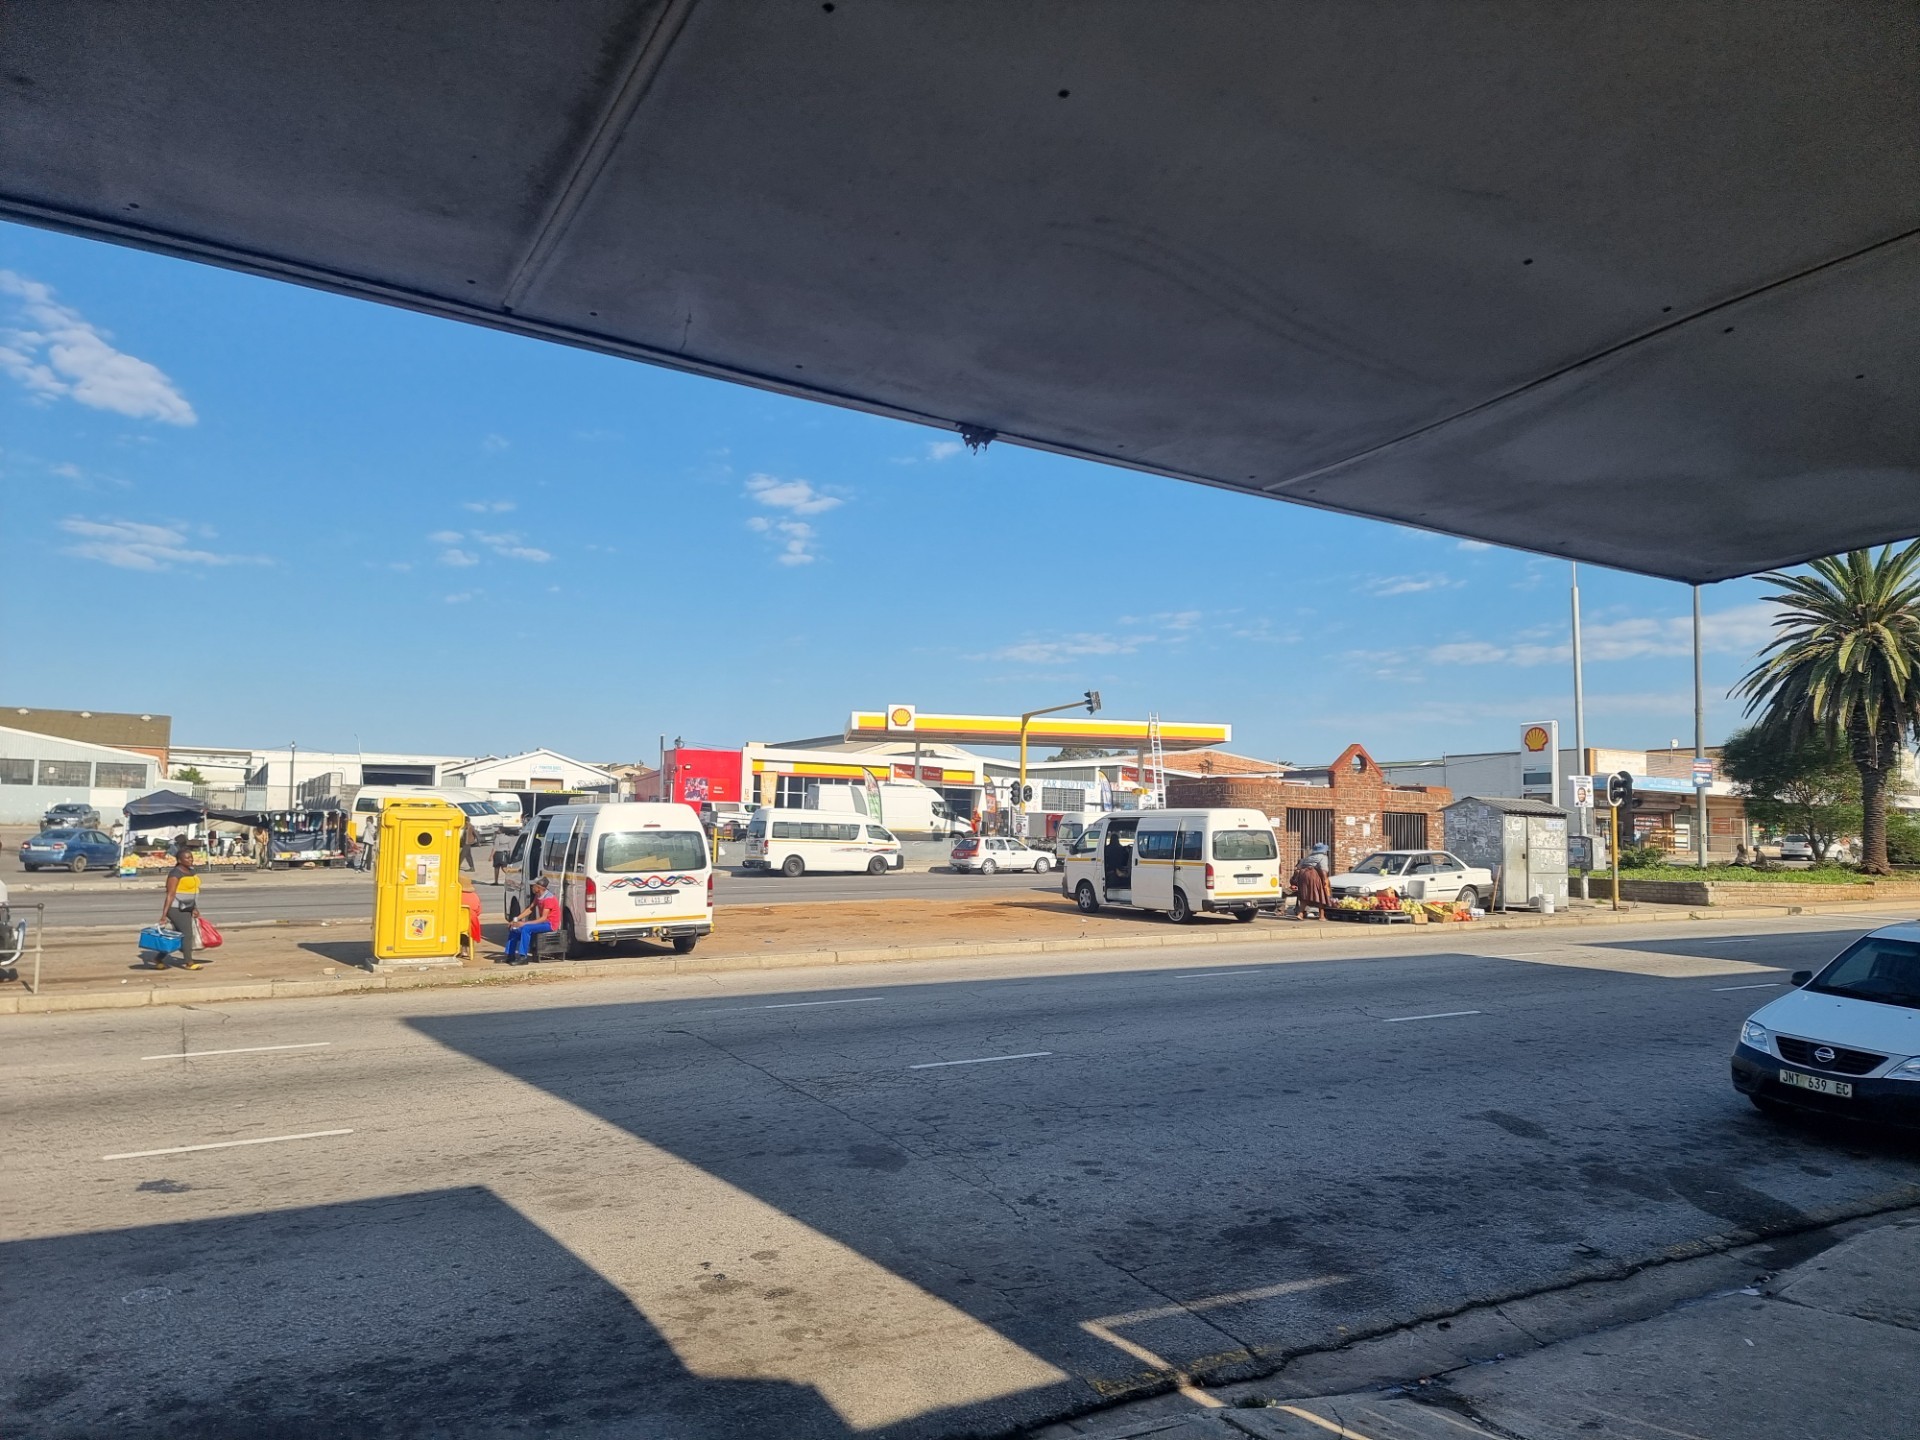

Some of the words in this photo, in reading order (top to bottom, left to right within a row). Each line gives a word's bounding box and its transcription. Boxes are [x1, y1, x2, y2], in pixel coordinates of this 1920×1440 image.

[1782, 1071, 1800, 1085] JNT
[1808, 1079, 1827, 1091] 639
[1836, 1083, 1849, 1095] EC
